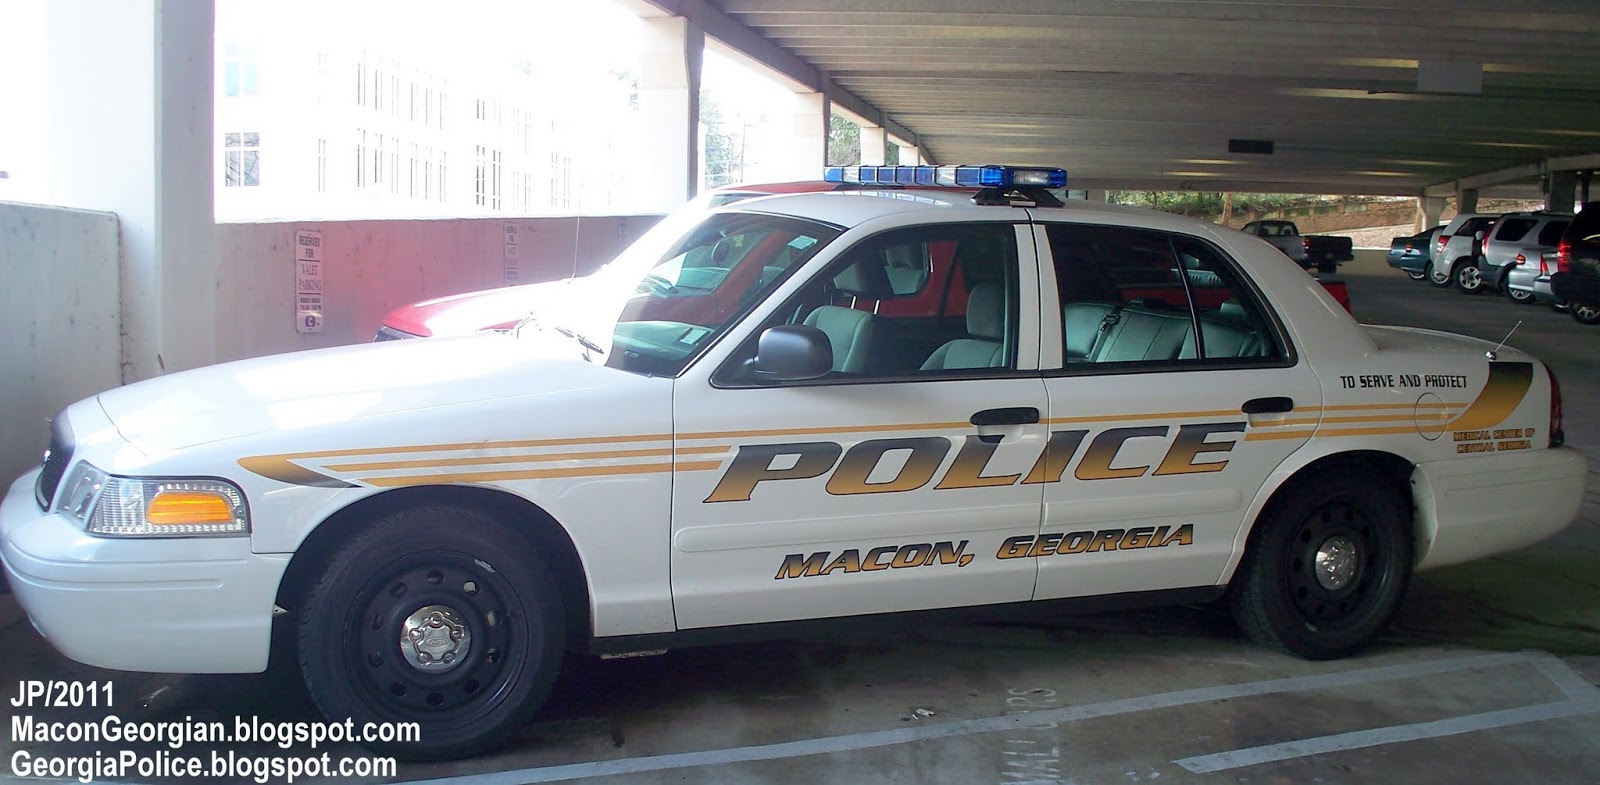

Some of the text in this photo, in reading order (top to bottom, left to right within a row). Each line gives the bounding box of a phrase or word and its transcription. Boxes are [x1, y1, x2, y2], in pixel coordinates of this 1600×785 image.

[305, 248, 314, 258] FOR
[302, 263, 318, 275] VALET
[299, 279, 321, 290] PARKING
[1340, 375, 1467, 388] TO SERVE AND PROTECT
[1453, 431, 1491, 441] MEDICAL
[703, 422, 1247, 503] POLICE
[775, 524, 1193, 580] MACON, GEORGIA
